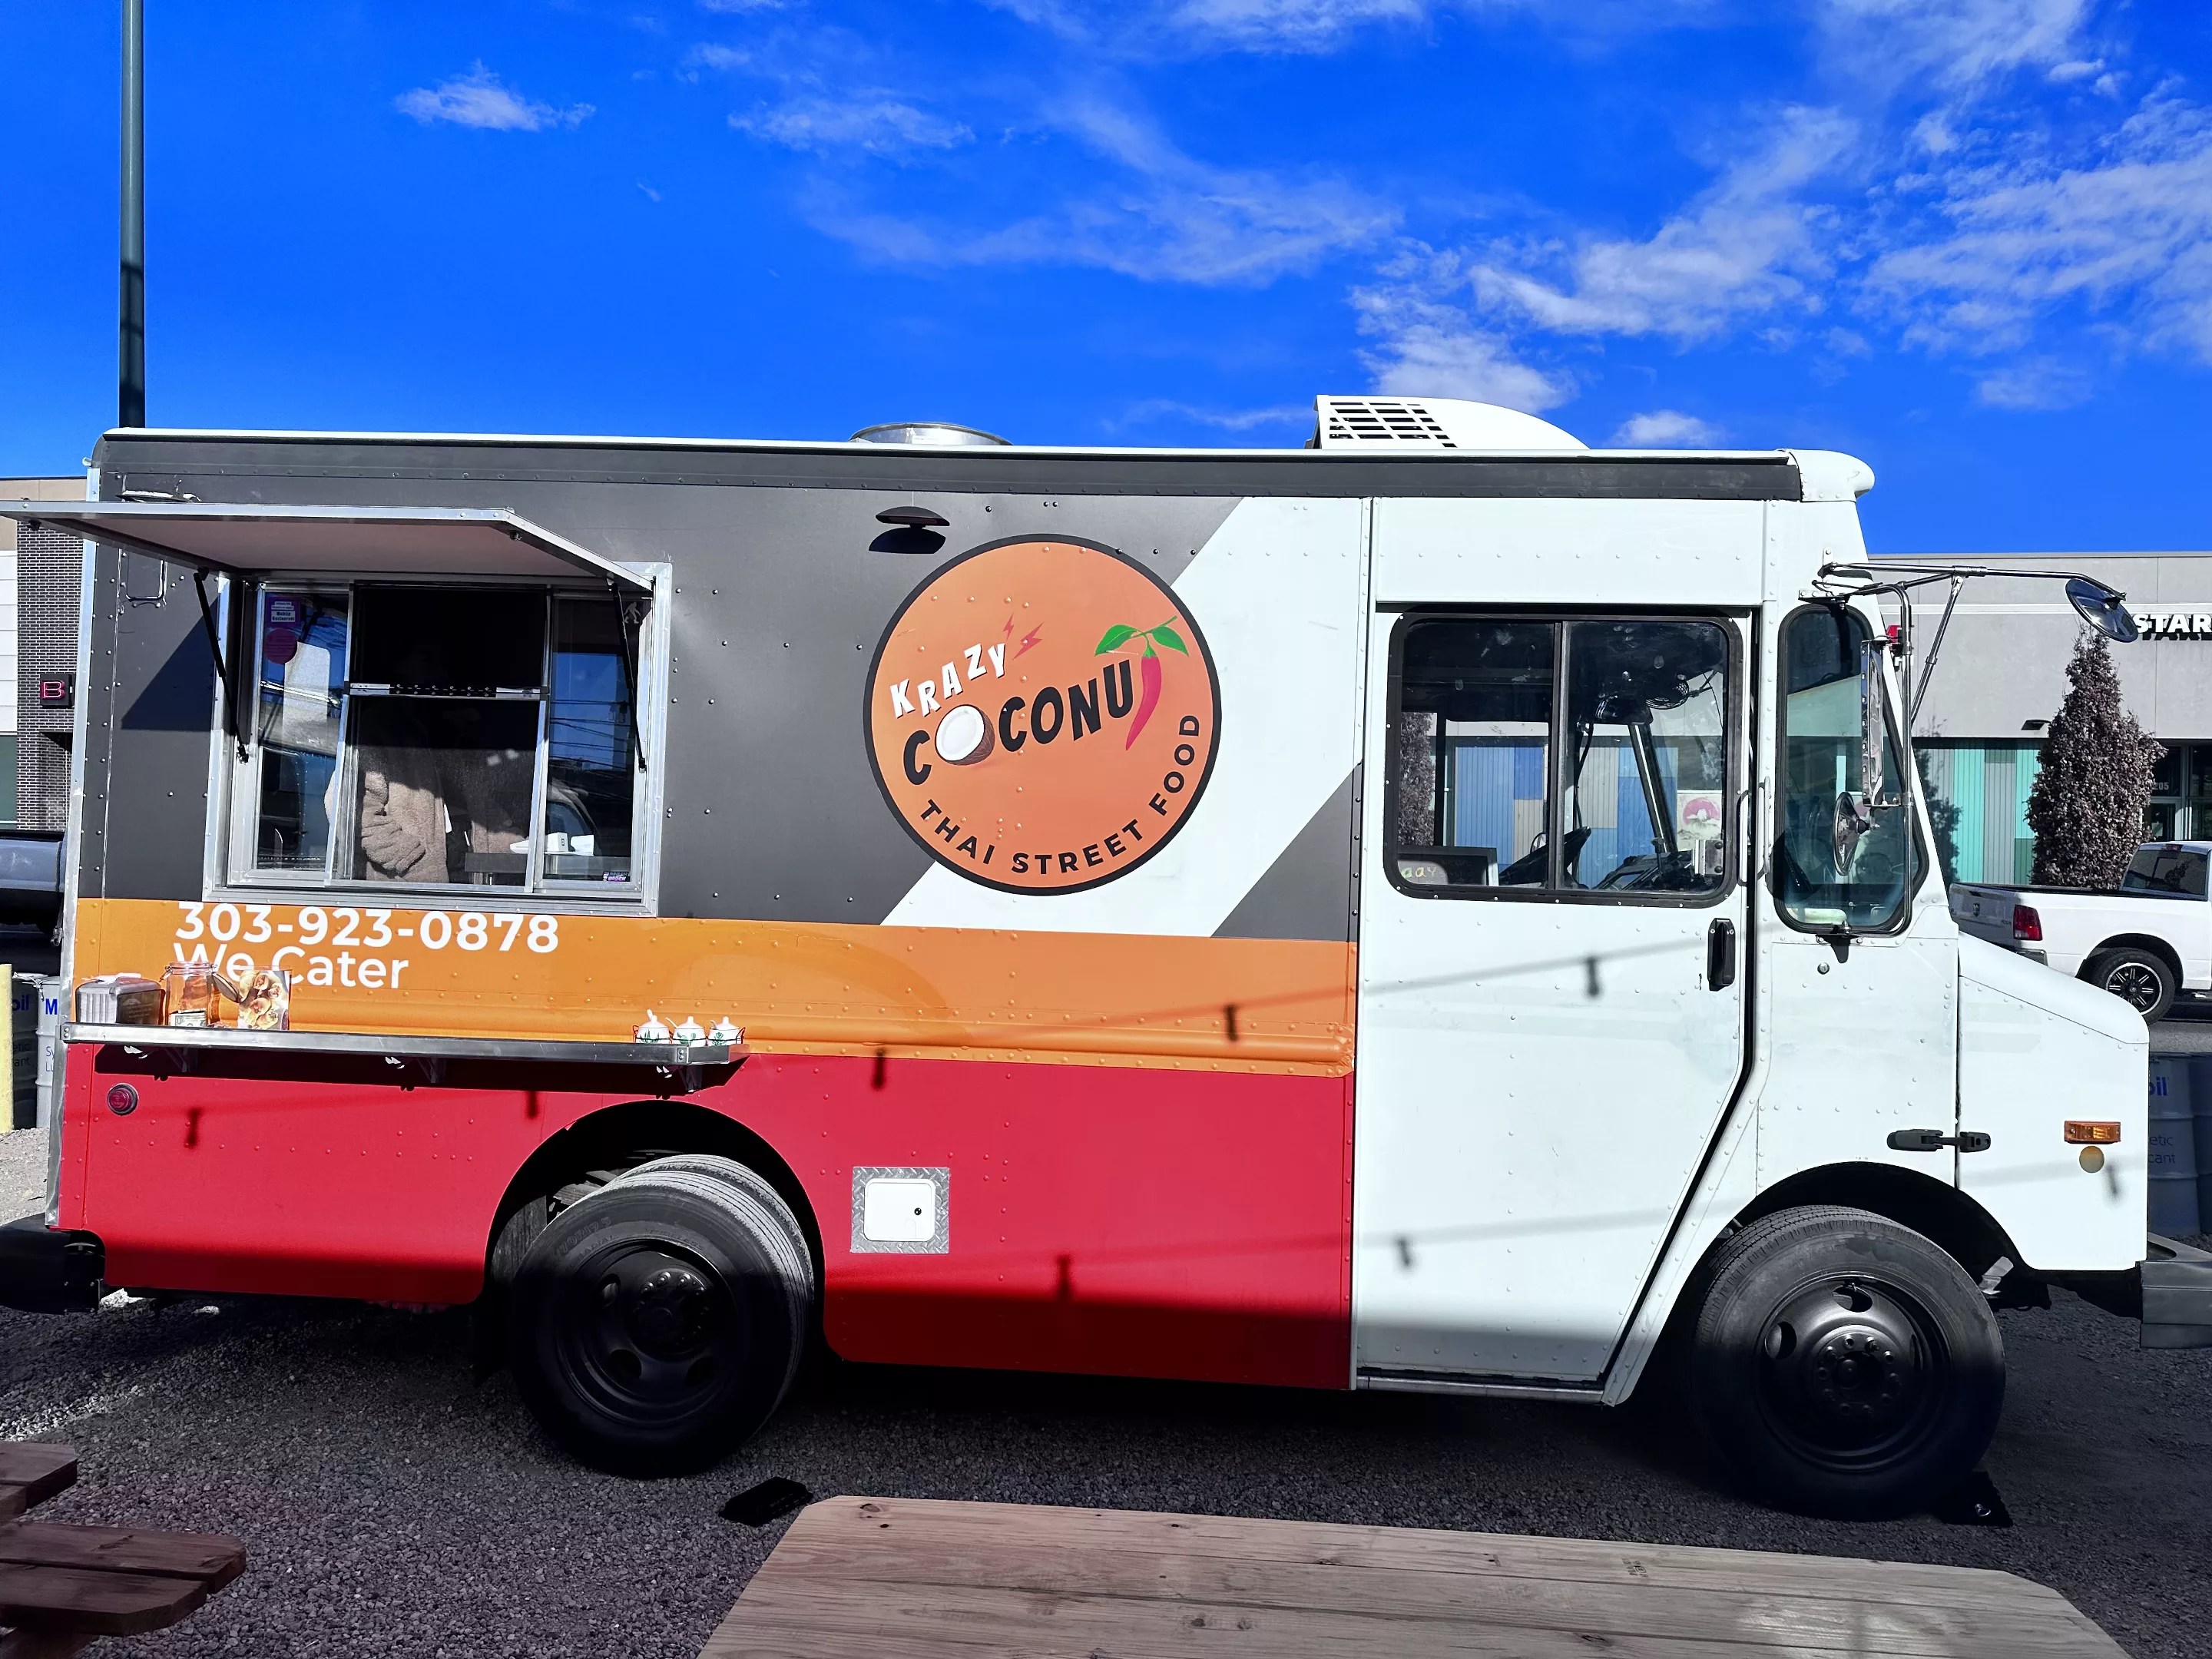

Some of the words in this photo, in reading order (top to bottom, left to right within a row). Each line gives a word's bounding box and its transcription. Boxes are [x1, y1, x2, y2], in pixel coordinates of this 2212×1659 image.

[41, 680, 65, 699] B
[890, 642, 1006, 719] KRAZY
[920, 800, 995, 865] THAI
[1011, 820, 1144, 875] STREET
[1148, 715, 1200, 816] FOOD
[175, 901, 558, 953] 303-923-0878
[174, 942, 254, 983] We
[272, 945, 409, 988] Cater
